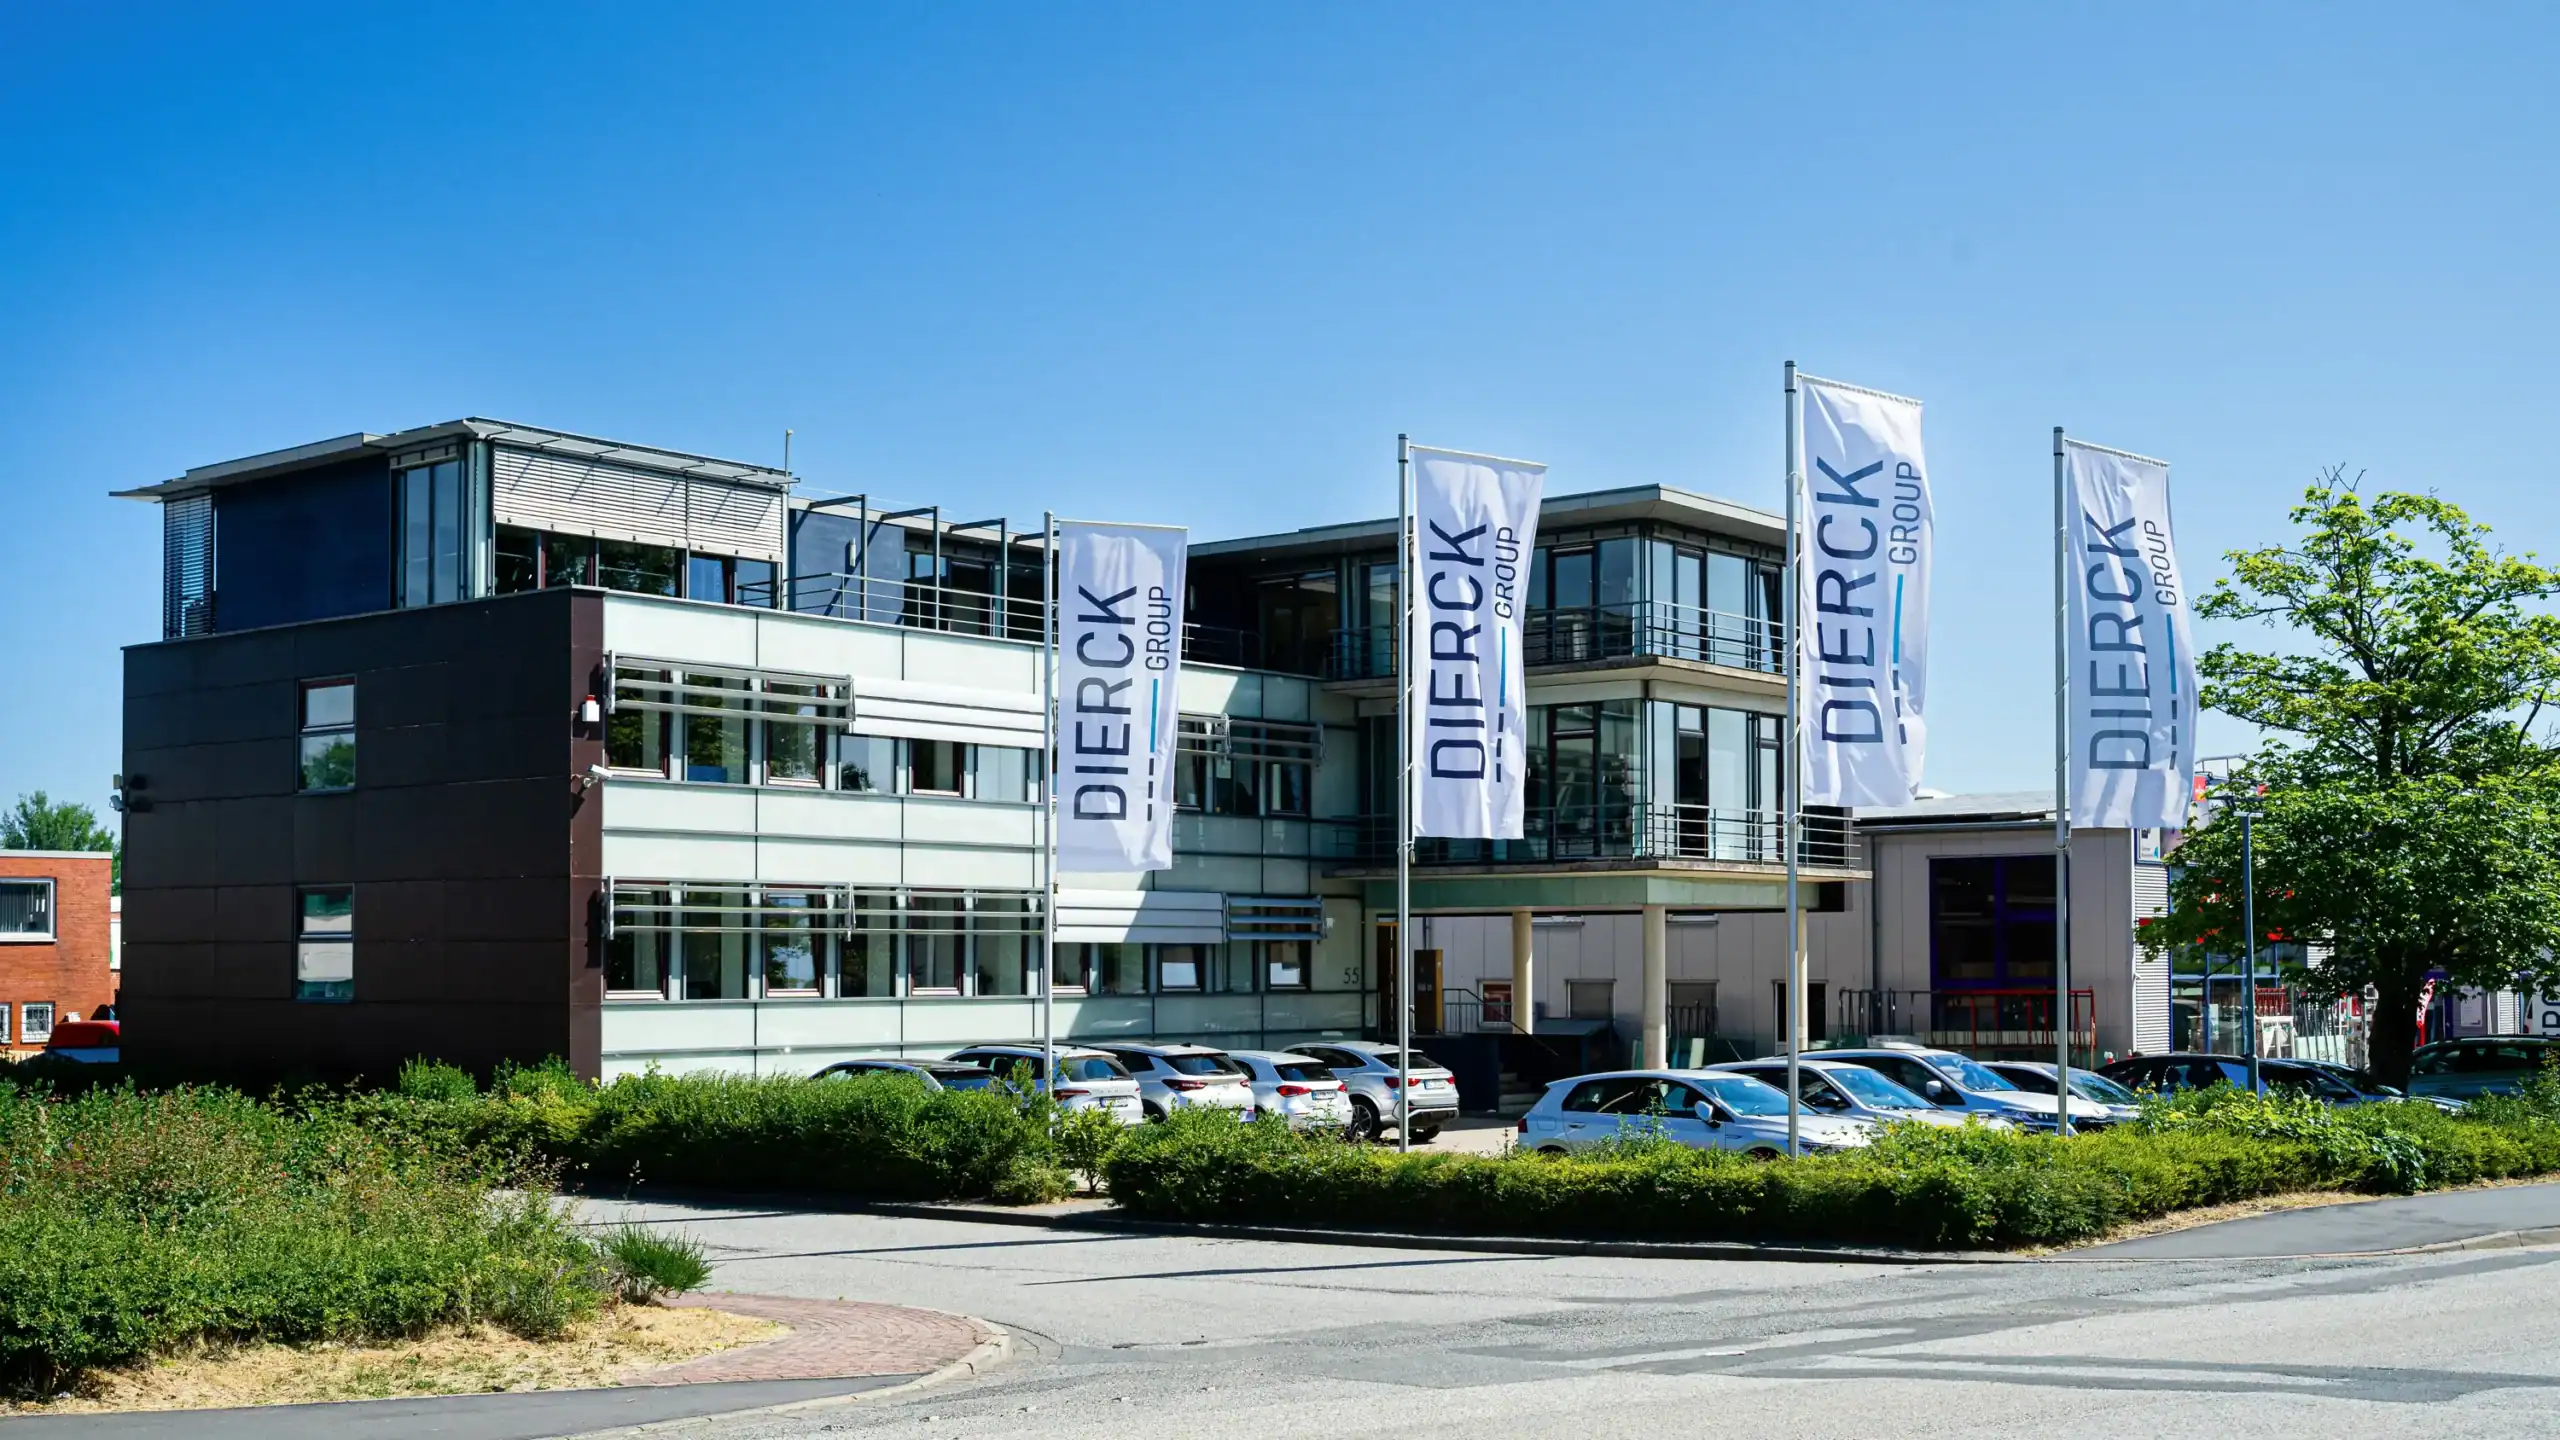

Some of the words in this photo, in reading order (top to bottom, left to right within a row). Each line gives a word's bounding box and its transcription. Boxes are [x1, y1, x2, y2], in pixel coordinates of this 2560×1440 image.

[1888, 461, 1922, 565] GROUP
[2143, 519, 2178, 607] GROUP
[1494, 526, 1521, 620] GROUP
[1816, 455, 1884, 744] DIERCK
[1145, 585, 1172, 671] GROUP
[1428, 518, 1488, 780] DIERCK
[2085, 510, 2153, 771] DIERCK
[1073, 584, 1138, 821] DIERCK
[1343, 966, 1360, 985] 55
